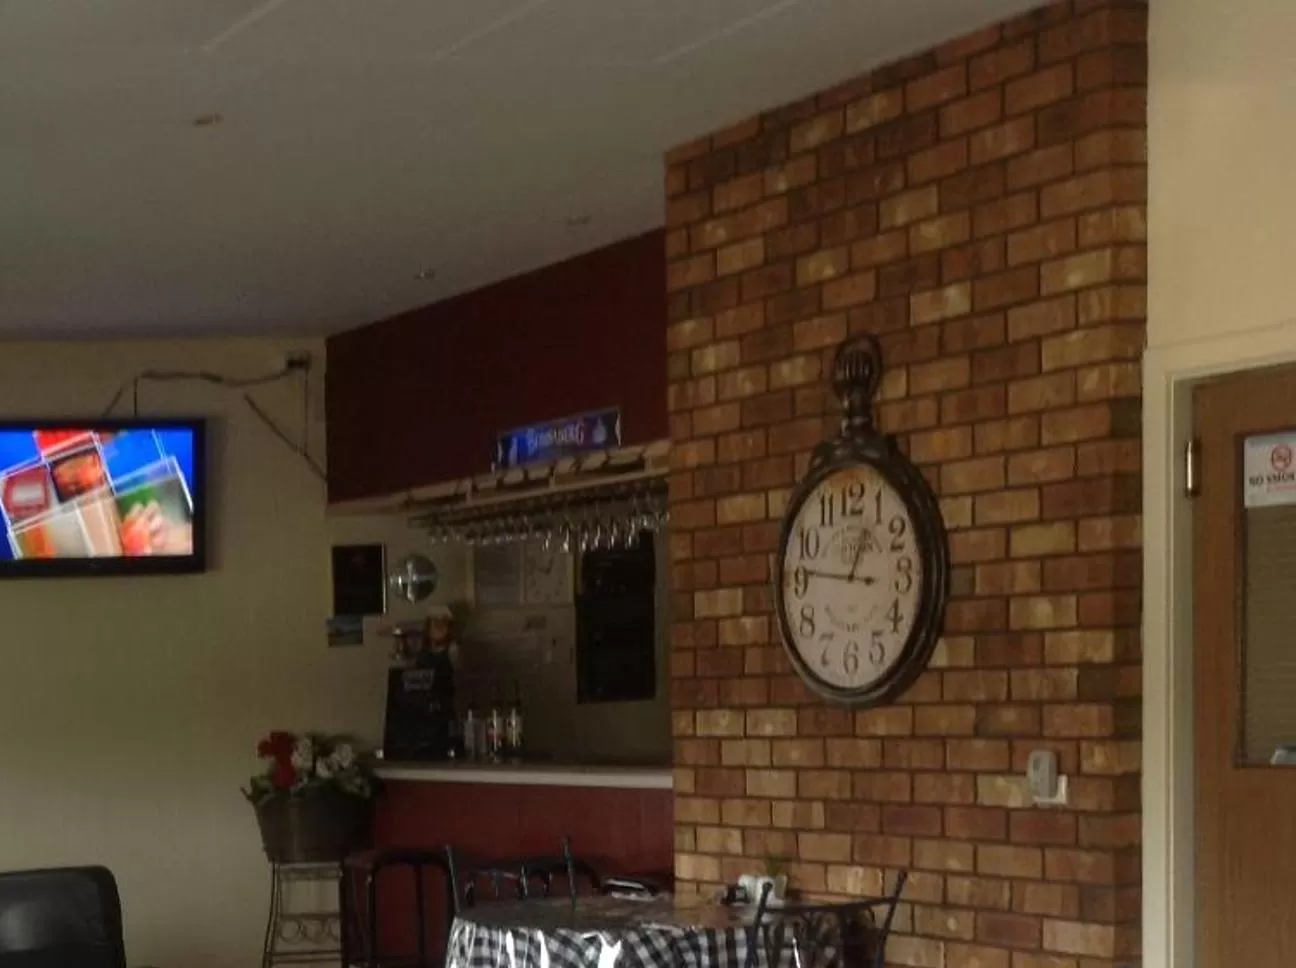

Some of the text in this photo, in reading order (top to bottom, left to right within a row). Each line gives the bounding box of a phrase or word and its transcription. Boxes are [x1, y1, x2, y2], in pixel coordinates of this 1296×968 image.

[820, 491, 834, 528] 11
[841, 482, 865, 517] 12
[874, 486, 882, 525] 1
[798, 526, 820, 561] 10
[887, 515, 906, 551] 2
[793, 565, 809, 600] 9
[894, 556, 913, 595] 3
[799, 603, 816, 639] 8
[884, 597, 905, 634] 4
[818, 632, 835, 668] 7
[843, 639, 859, 676] 6
[868, 630, 886, 666] 5
